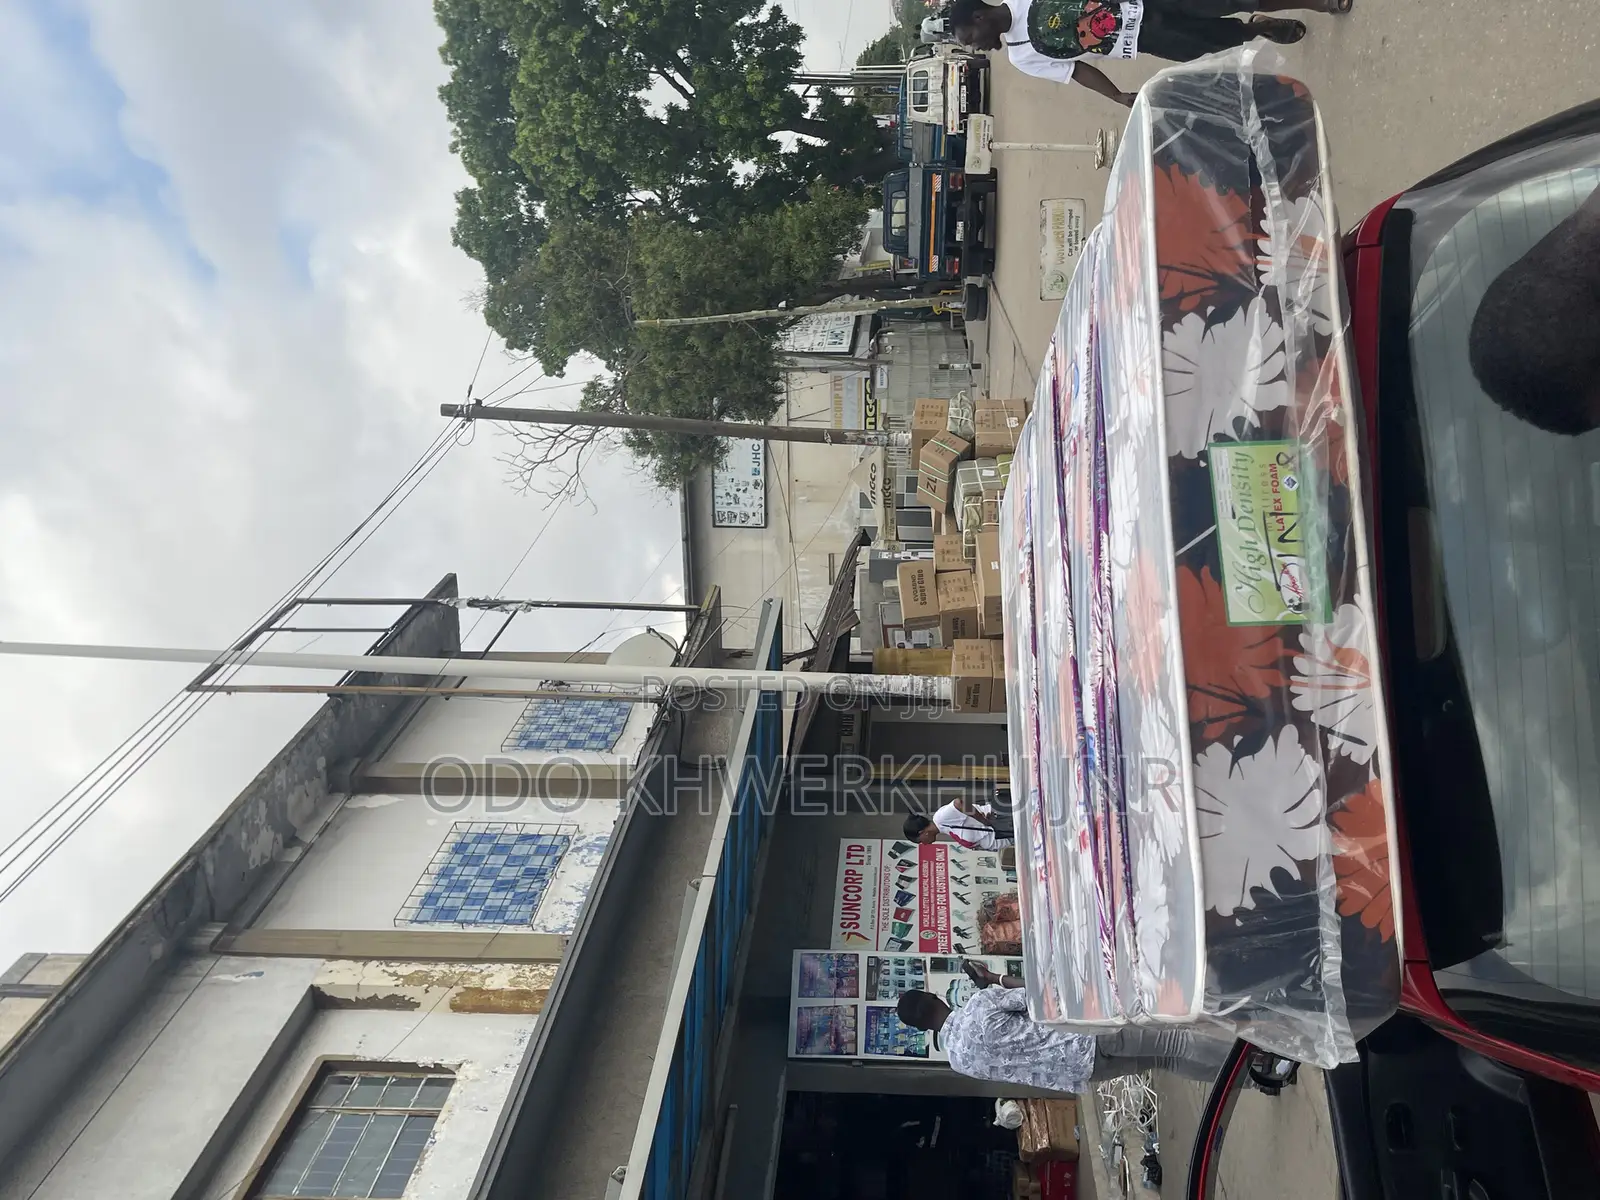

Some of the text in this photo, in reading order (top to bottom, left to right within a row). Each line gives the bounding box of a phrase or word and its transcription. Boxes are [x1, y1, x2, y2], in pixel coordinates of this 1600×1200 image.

[752, 444, 761, 467] JHC
[1269, 464, 1280, 494] FOAM
[1259, 464, 1273, 531] mattress
[1232, 452, 1266, 614] High Density
[916, 569, 927, 605] Super Glue
[840, 845, 865, 929] SUNCORP LTD
[936, 848, 948, 953] STREET PARKING FOR CUSTOMERS ONLY
